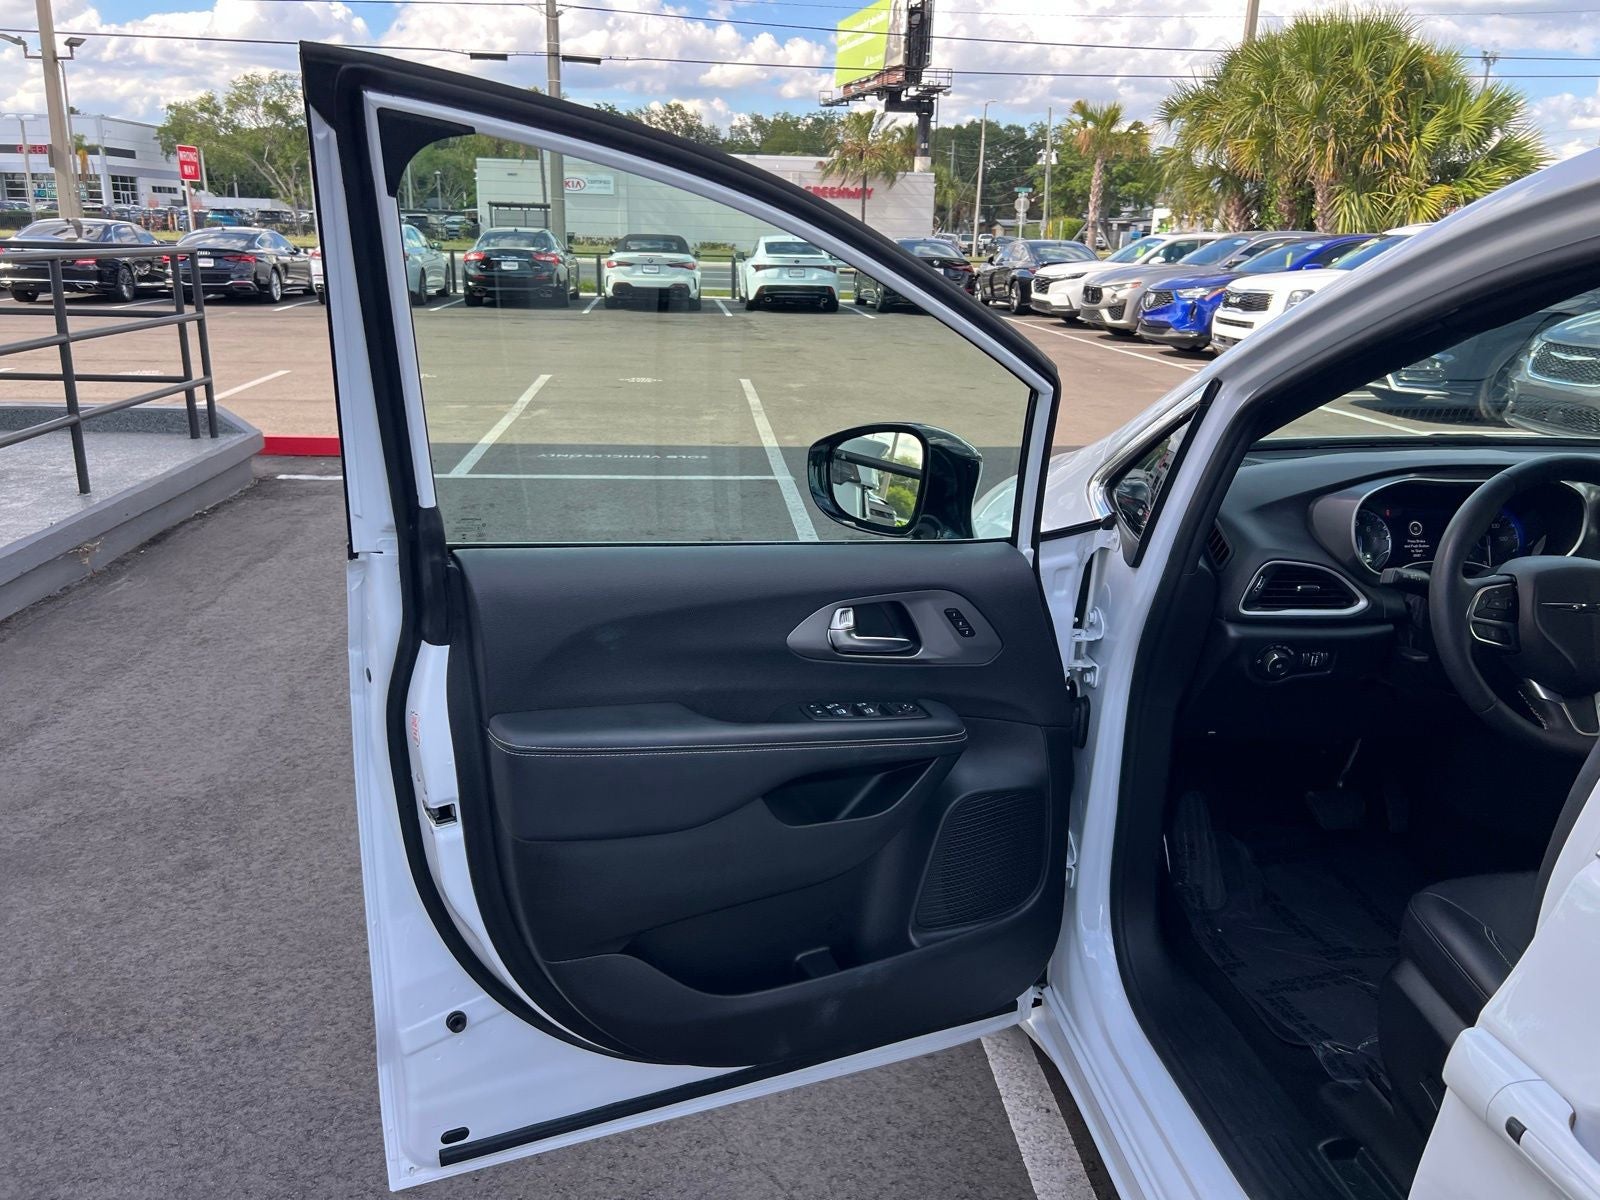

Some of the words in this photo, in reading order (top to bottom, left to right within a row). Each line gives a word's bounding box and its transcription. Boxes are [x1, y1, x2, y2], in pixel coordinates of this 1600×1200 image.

[178, 150, 198, 162] WRONG
[183, 164, 196, 175] WAY
[564, 180, 582, 188] KIA
